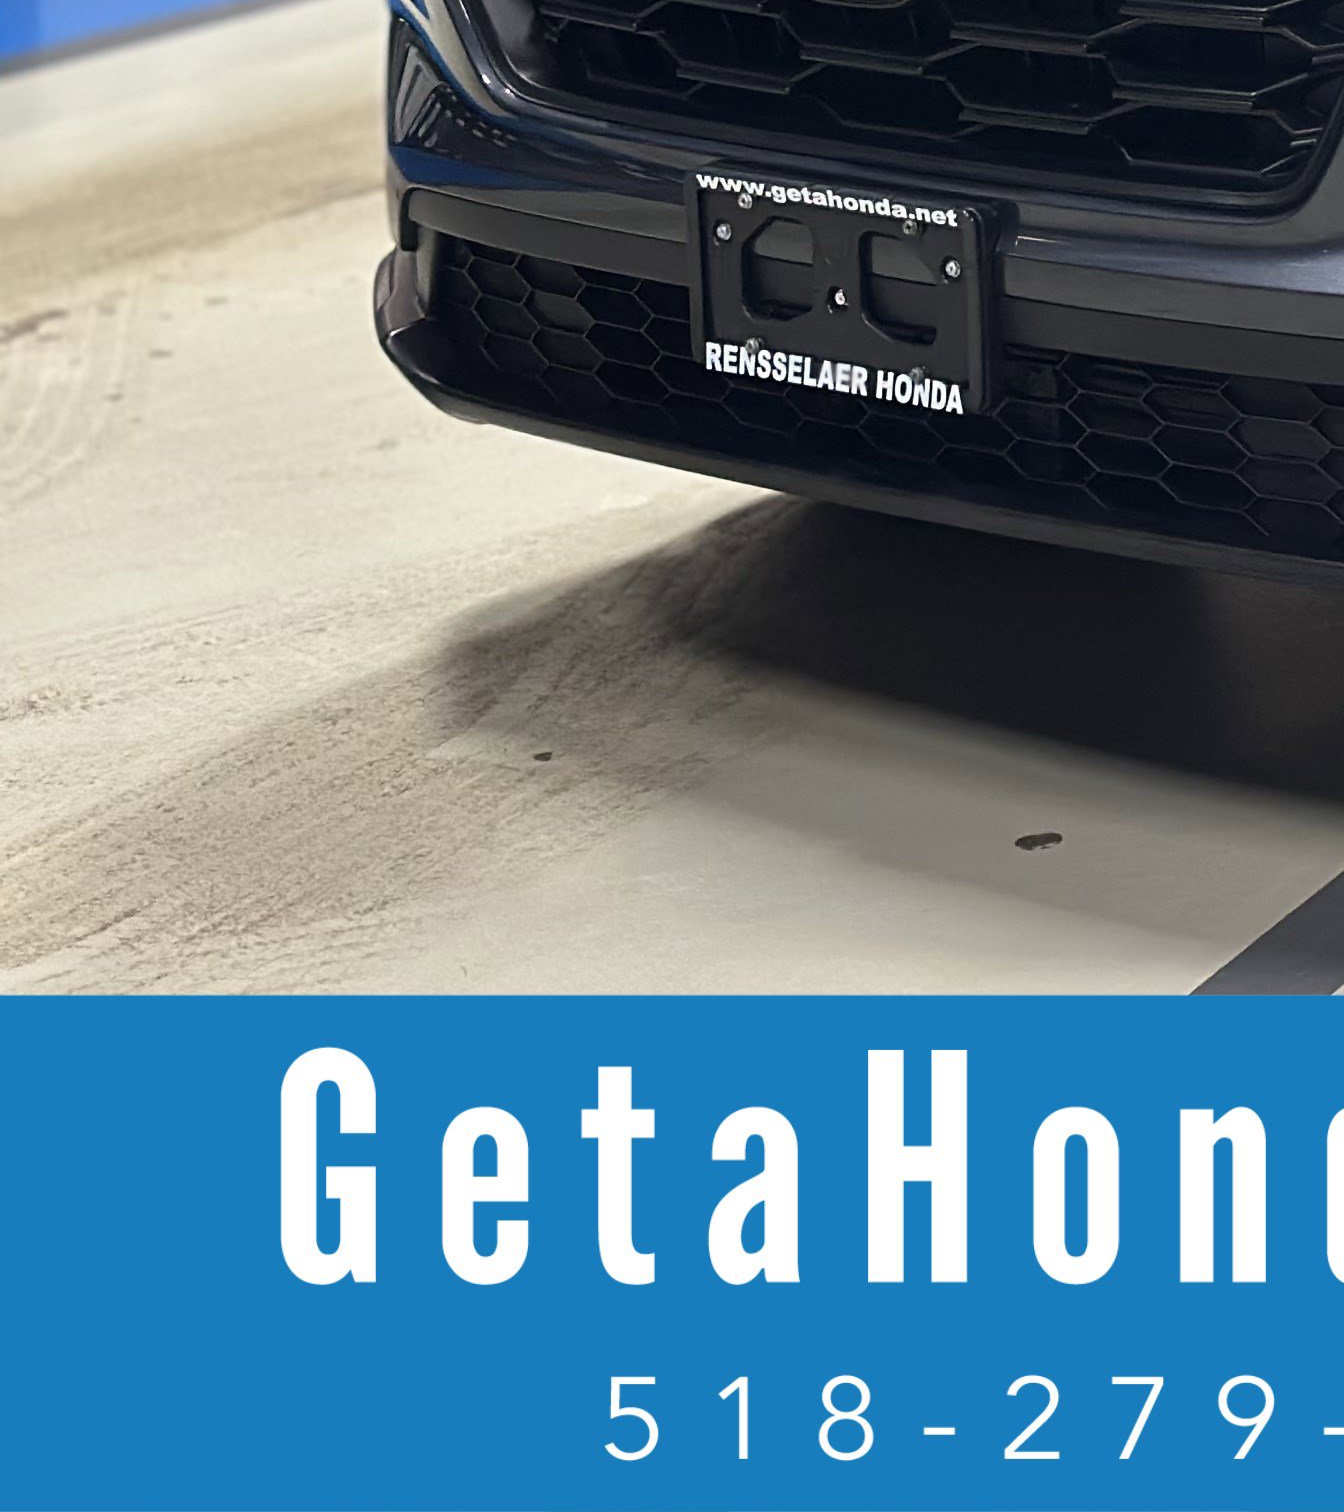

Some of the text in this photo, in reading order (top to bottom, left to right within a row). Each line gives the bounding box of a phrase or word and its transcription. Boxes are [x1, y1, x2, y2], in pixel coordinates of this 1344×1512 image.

[696, 174, 958, 227] www.getahonda.net
[705, 341, 964, 415] RENSSELAER HONDA
